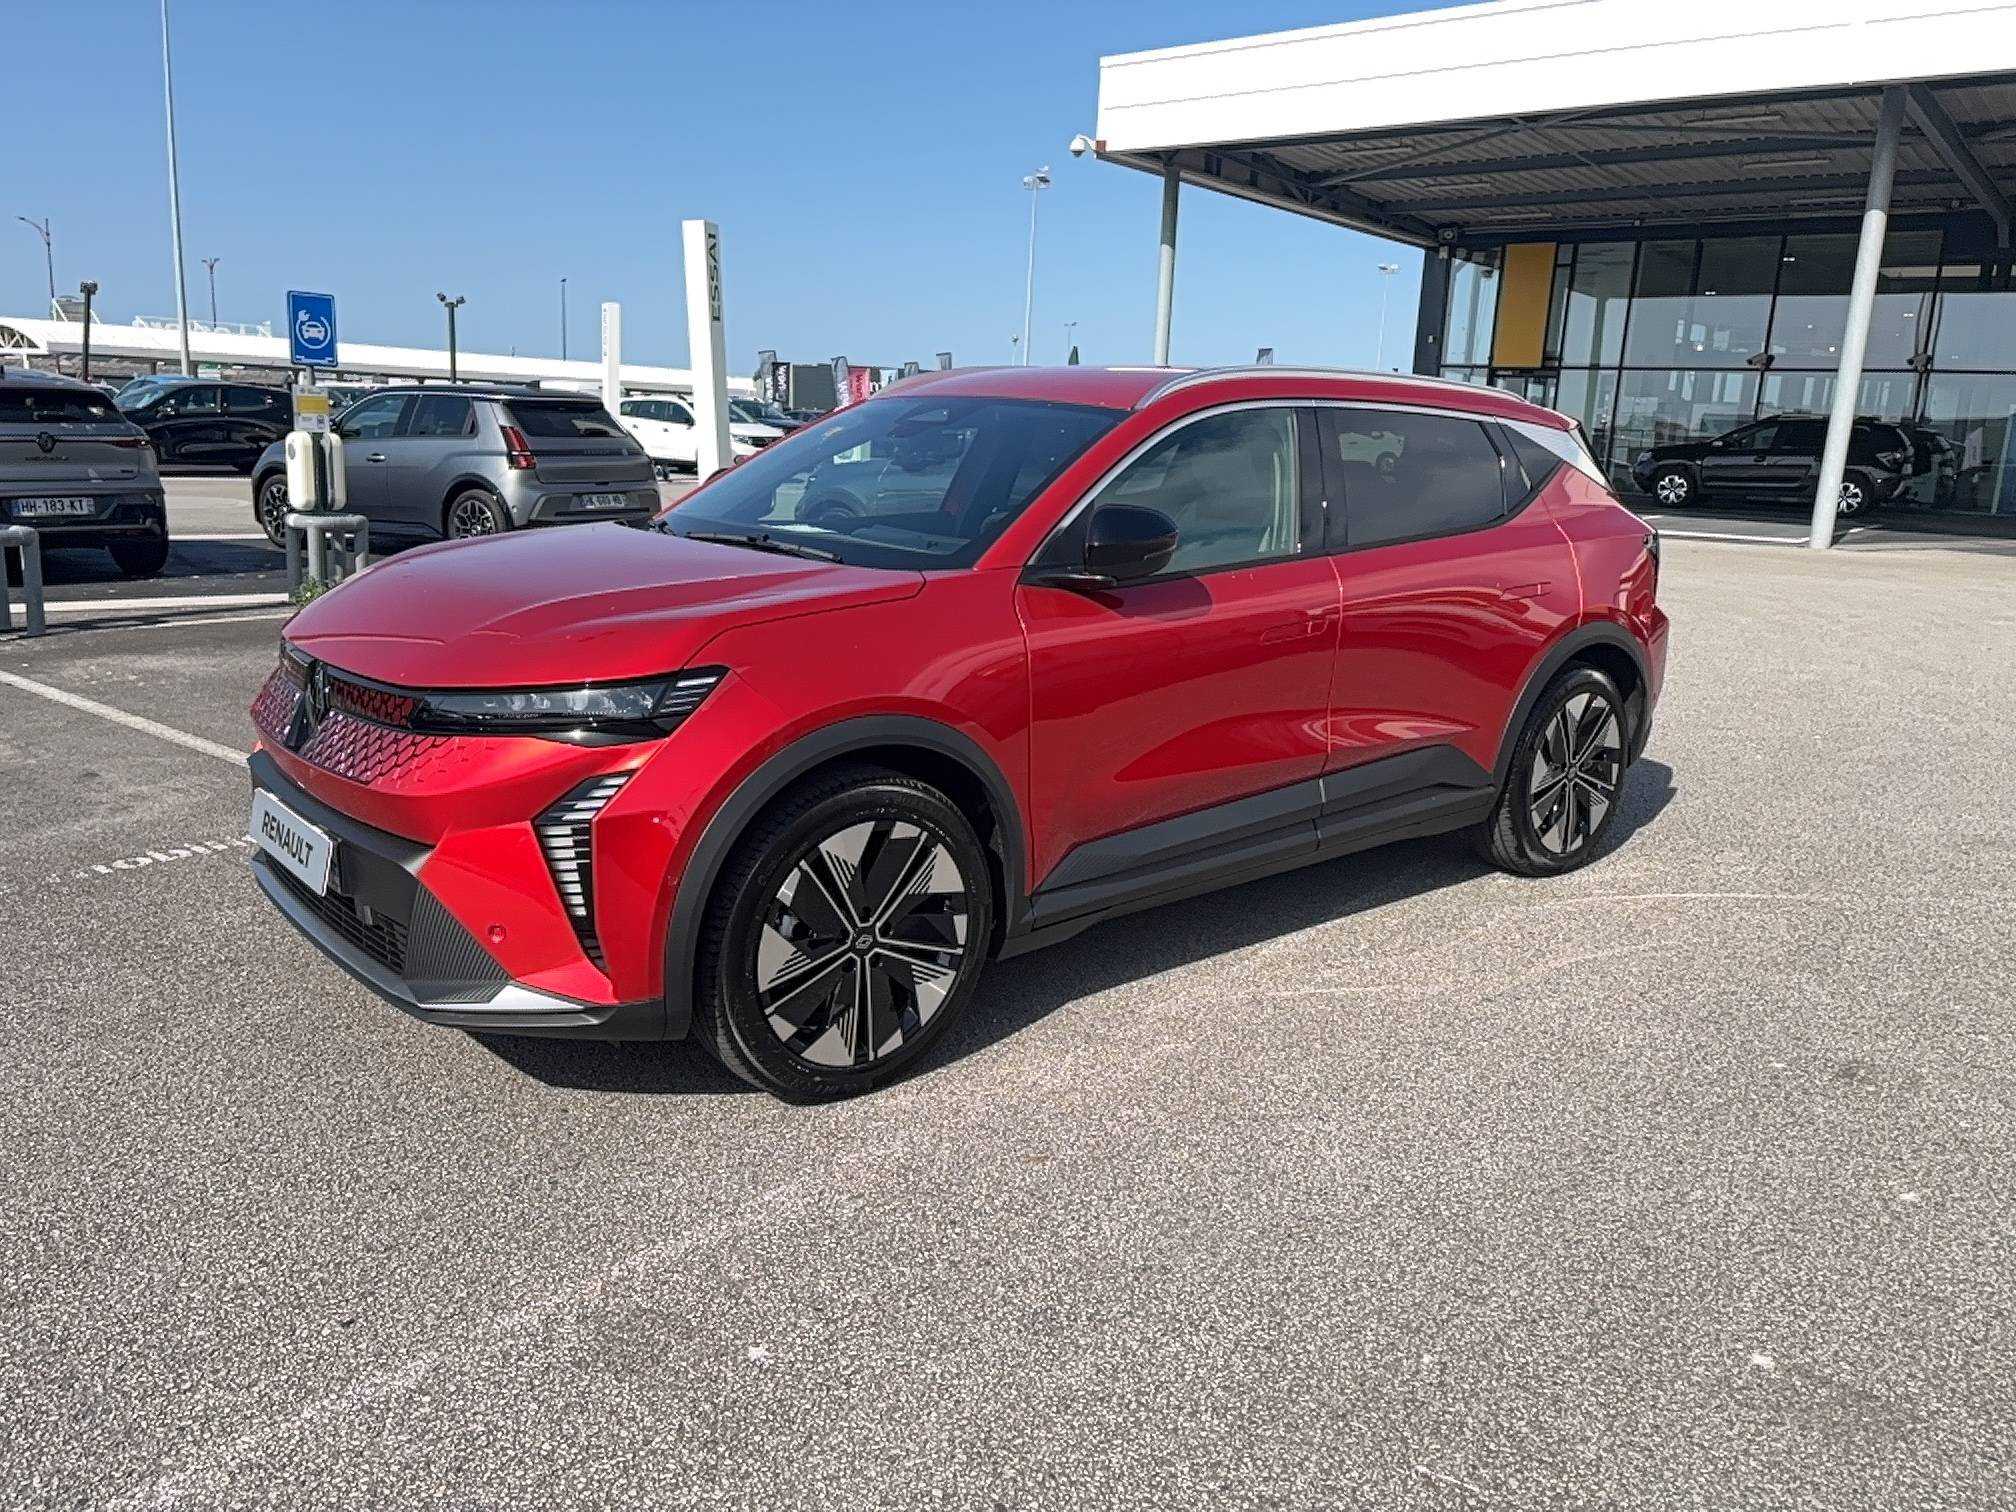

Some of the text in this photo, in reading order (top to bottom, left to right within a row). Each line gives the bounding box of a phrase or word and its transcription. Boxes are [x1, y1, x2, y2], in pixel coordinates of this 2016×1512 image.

[707, 233, 721, 321] ESSAI
[20, 498, 84, 513] HH-183-KT
[262, 810, 314, 868] RENAULT
